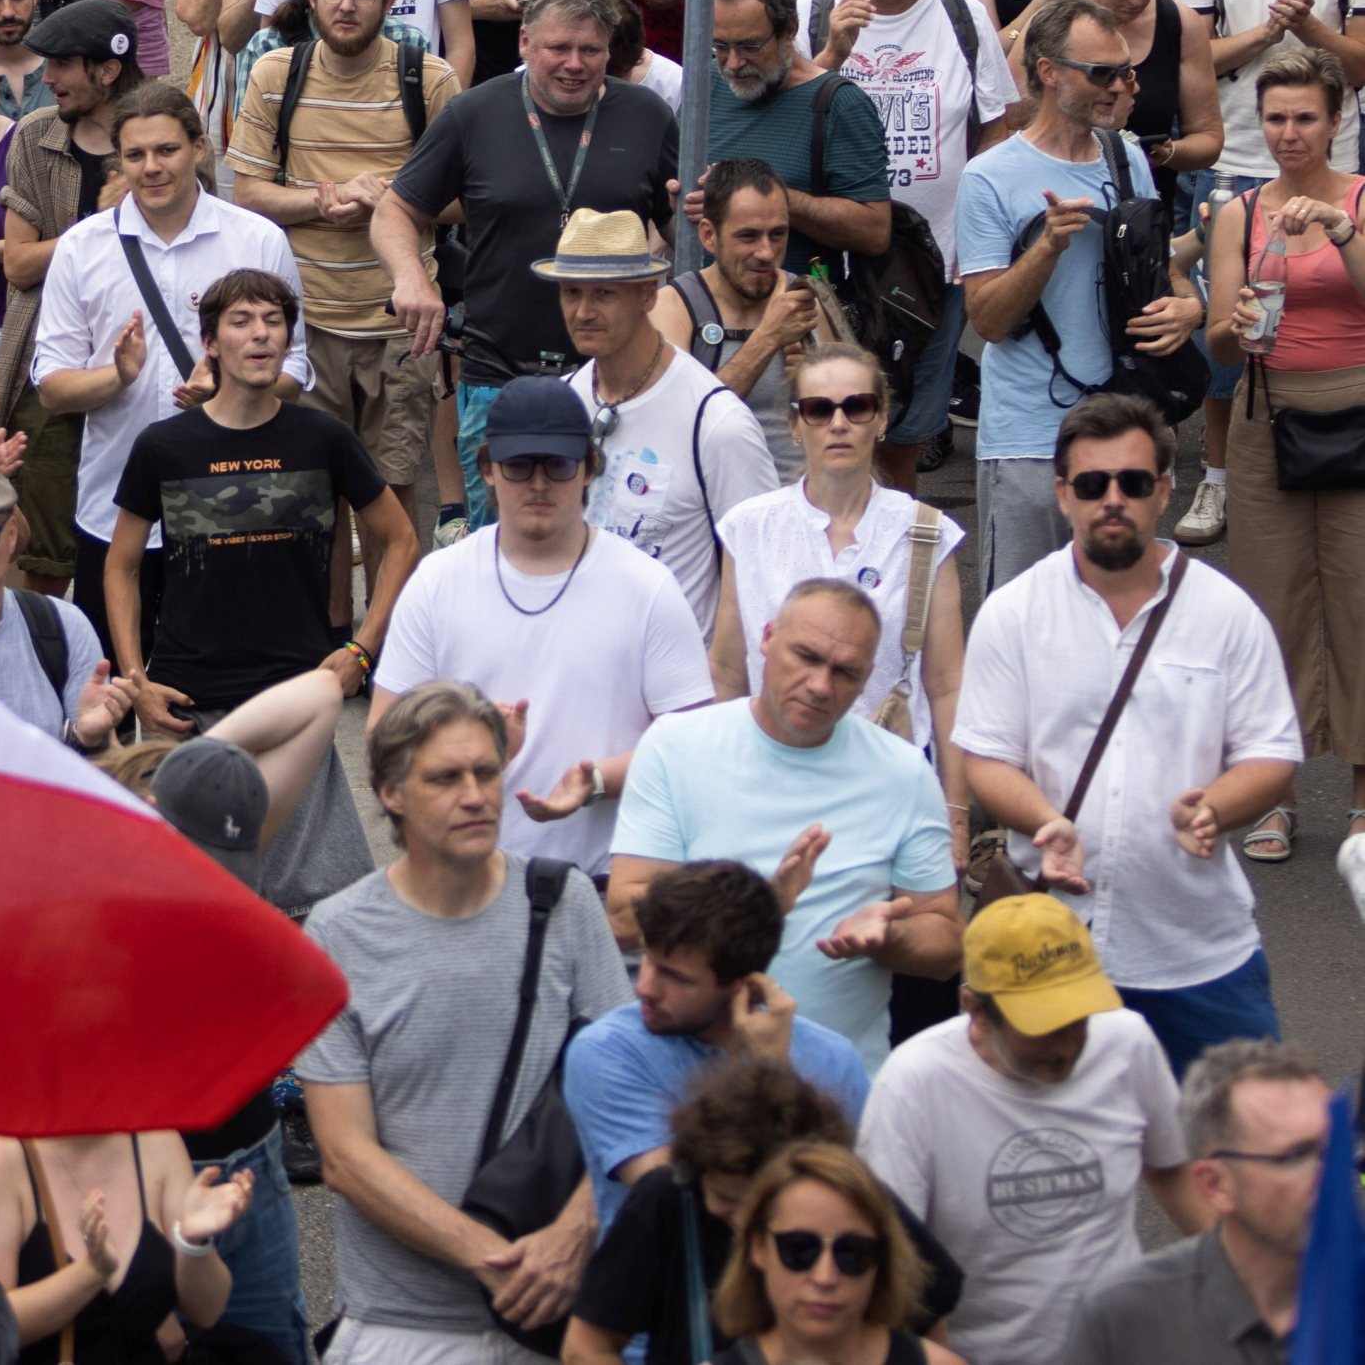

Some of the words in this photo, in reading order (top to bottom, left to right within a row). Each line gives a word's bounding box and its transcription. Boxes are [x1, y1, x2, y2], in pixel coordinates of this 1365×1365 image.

[841, 67, 874, 81] UALITY
[892, 69, 935, 82] CLOTHING
[870, 90, 932, 132] VI'S
[884, 135, 932, 156] DED
[886, 168, 913, 188] 73
[210, 461, 240, 473] NEW
[243, 458, 282, 470] YORK
[223, 536, 246, 544] VIBES
[992, 1166, 1100, 1200] BUSHMAN
